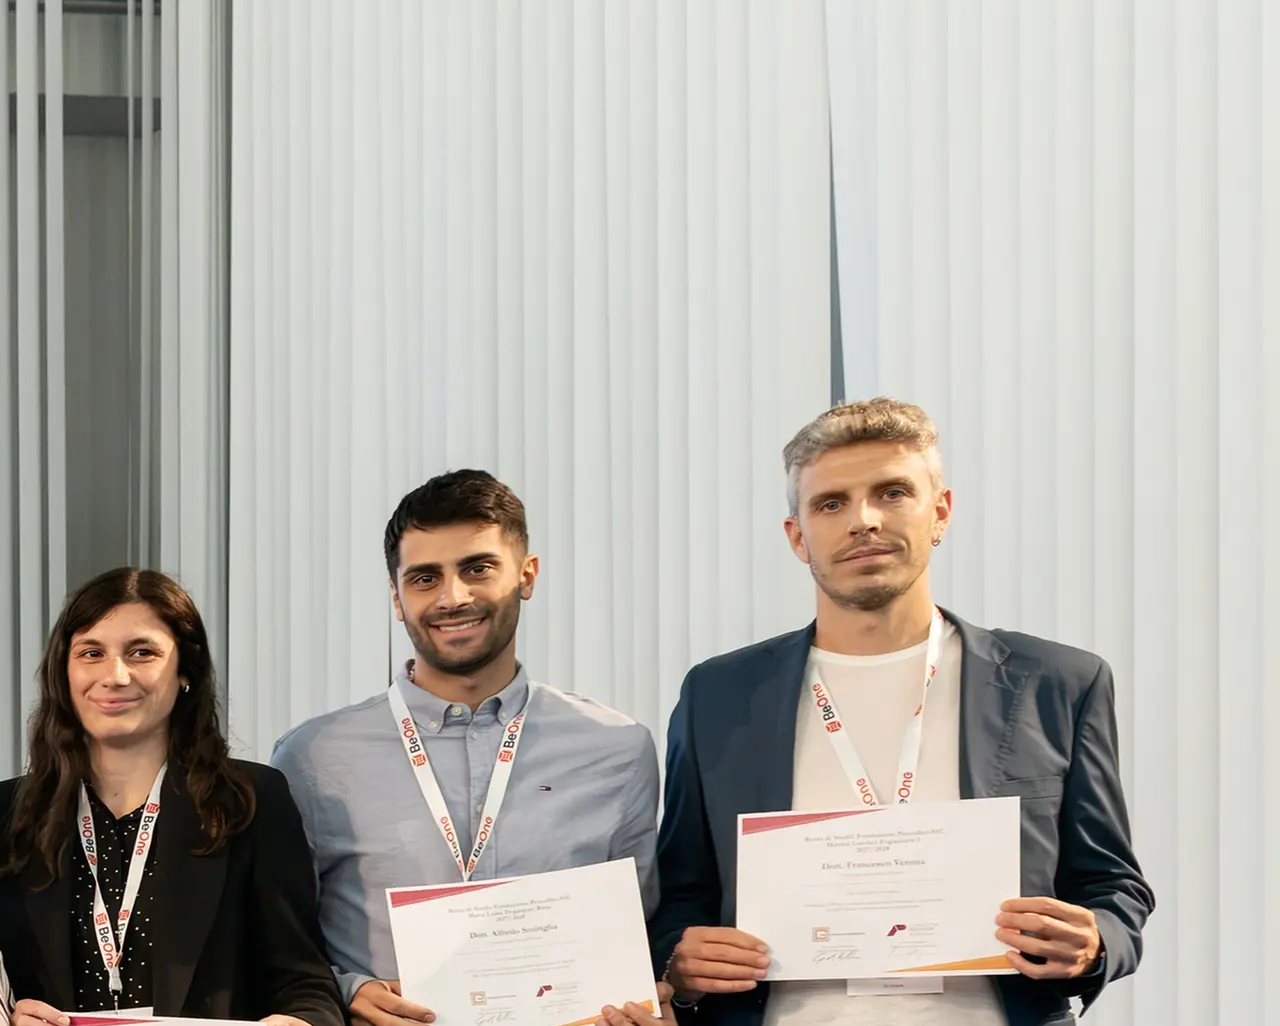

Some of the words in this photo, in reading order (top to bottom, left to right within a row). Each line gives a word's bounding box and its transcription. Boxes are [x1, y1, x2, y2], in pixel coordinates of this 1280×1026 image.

[812, 682, 836, 722] BeOne
[401, 717, 421, 754] BeOne
[82, 815, 95, 854] BeOne
[134, 815, 155, 856] BeOne
[472, 816, 494, 859] BeOne
[98, 926, 114, 969] BeOne
